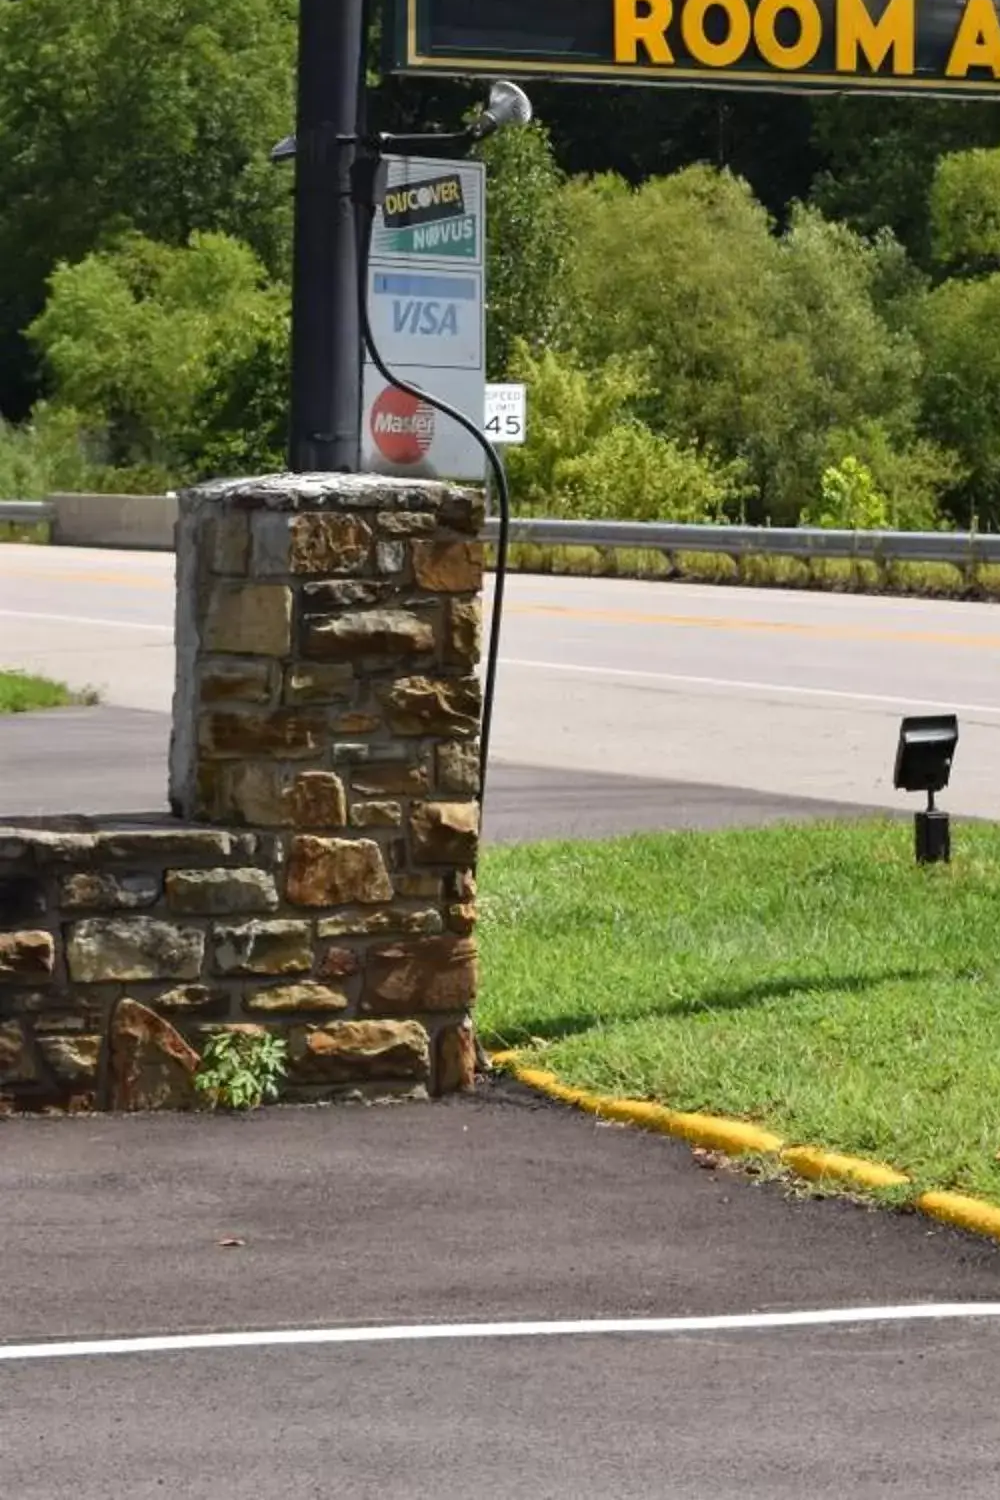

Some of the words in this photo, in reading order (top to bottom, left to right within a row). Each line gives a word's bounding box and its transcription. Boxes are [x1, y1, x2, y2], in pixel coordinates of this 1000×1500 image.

[413, 219, 473, 250] NOVUS
[392, 300, 458, 336] VISA
[484, 415, 521, 435] 45
